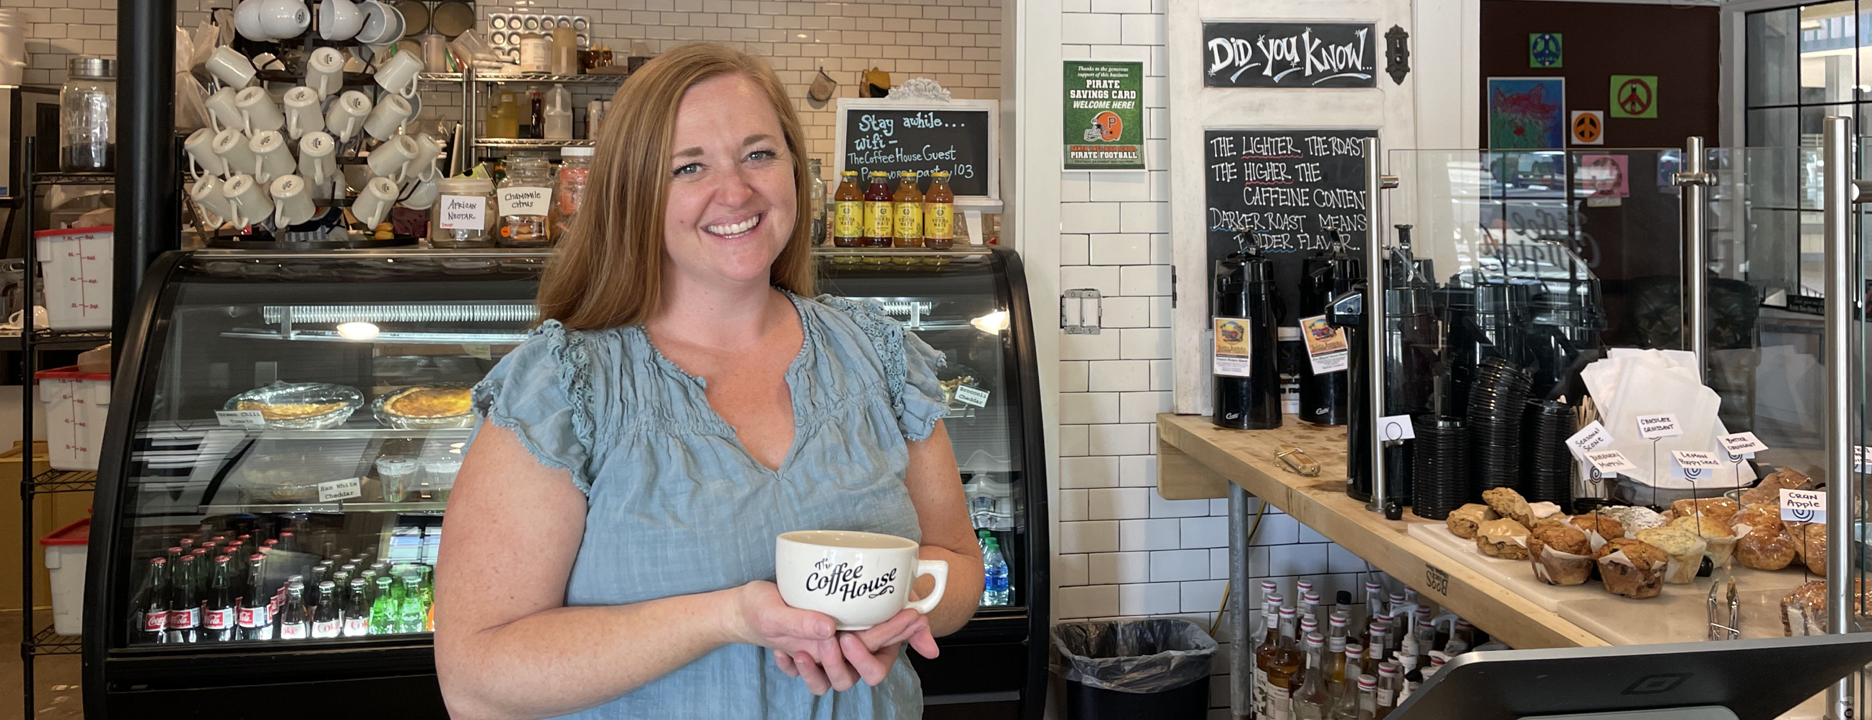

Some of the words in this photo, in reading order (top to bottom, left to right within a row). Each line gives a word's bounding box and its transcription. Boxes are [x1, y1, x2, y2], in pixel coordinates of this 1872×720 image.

[1086, 79, 1120, 88] PIRATE
[1070, 90, 1109, 99] SAVINGS
[1111, 90, 1136, 99] CARD
[1073, 101, 1111, 109] WELCOME
[1112, 101, 1135, 109] HERE!
[859, 114, 894, 137] Stay
[1108, 117, 1117, 128] P
[1210, 136, 1237, 158] THE
[1242, 135, 1301, 155] LIGHTER
[1304, 136, 1330, 157] THE
[1328, 136, 1366, 158] ROAST
[1070, 151, 1098, 159] PIRATE
[1100, 151, 1138, 159] FOOTBALL
[1211, 162, 1237, 183] THE
[1244, 162, 1292, 182] HIGHER
[1295, 162, 1322, 183] THE
[1243, 186, 1310, 207] CAFFEINE
[1313, 188, 1366, 210] CONTEN
[1209, 207, 1266, 230] DARKER
[1265, 212, 1307, 233] ROAST
[1318, 213, 1367, 233] MEANS
[324, 490, 355, 499] Cheddar
[1787, 499, 1820, 508] Apple
[805, 562, 864, 597] Coffee
[839, 567, 897, 602] House
[350, 620, 369, 630] Cok
[282, 627, 298, 635] oke
